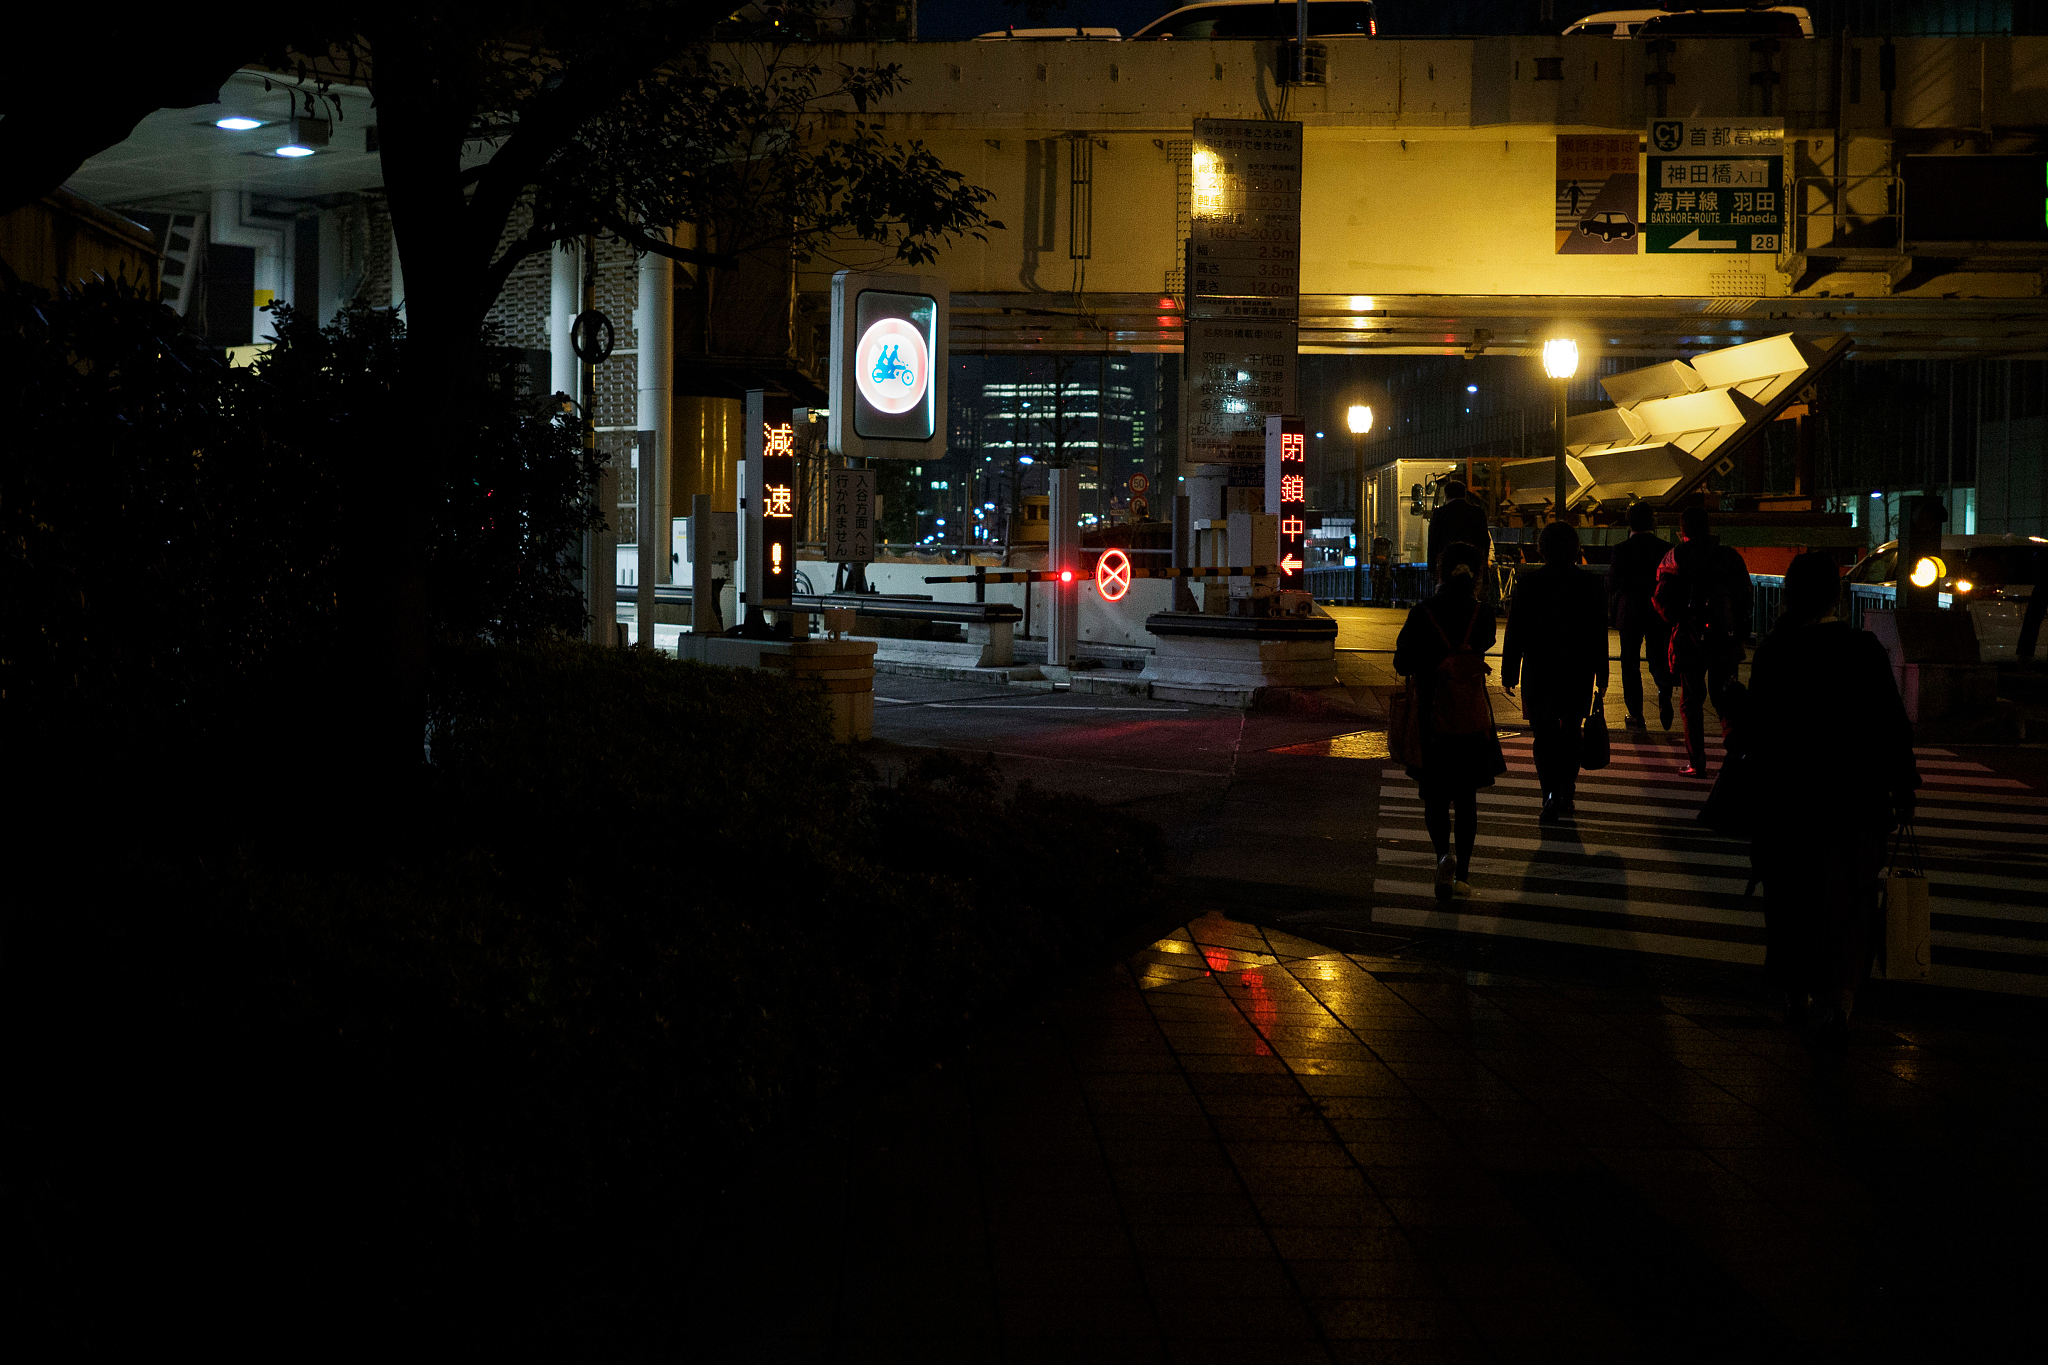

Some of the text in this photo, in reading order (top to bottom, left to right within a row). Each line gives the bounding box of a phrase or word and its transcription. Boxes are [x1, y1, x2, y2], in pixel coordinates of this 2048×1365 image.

[1655, 124, 1679, 142] C1
[1690, 126, 1777, 147] 首都高速
[1667, 164, 1762, 184] 神田橋入口
[1654, 191, 1775, 212] 湾岸線 羽田
[1731, 212, 1777, 223] Haneda
[1756, 236, 1774, 249] 28
[1258, 246, 1294, 259] 2.5m
[1196, 261, 1294, 277] 高さ 3.8m
[1195, 279, 1293, 294] 長さ 12.0m
[1202, 352, 1284, 366] 羽田 千代田
[1133, 479, 1144, 488] 50
[1281, 433, 1305, 542] 閉鎖中
[835, 474, 849, 556] 行かれません
[855, 475, 869, 556] 入谷方面へは
